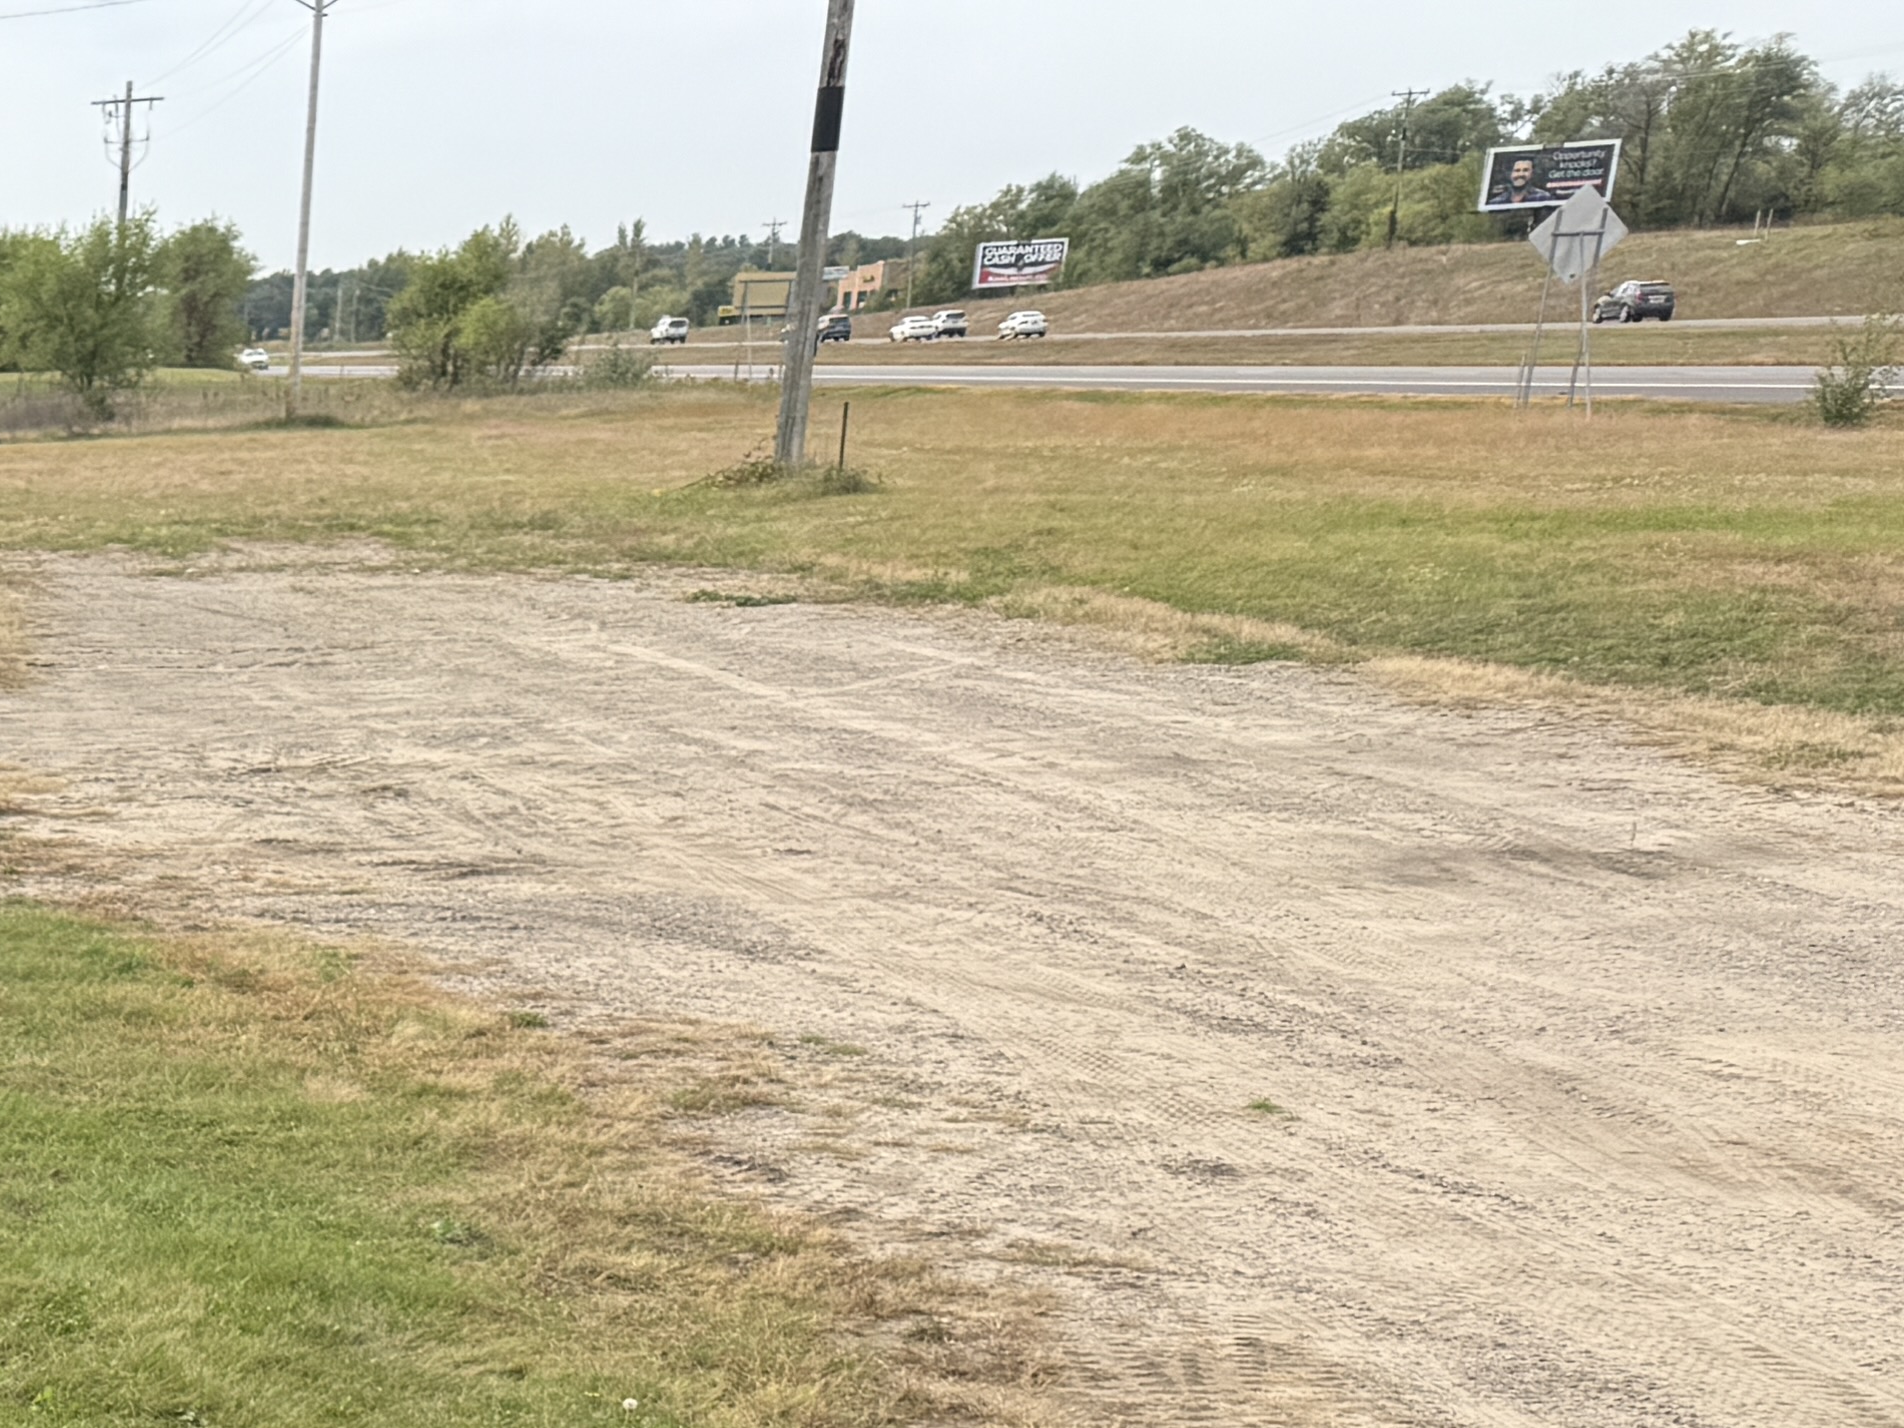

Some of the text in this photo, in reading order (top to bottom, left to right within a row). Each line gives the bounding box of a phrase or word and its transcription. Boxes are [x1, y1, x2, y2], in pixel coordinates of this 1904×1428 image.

[984, 243, 1063, 256] GUARANTEED
[983, 252, 1062, 265] CASH OFFER
